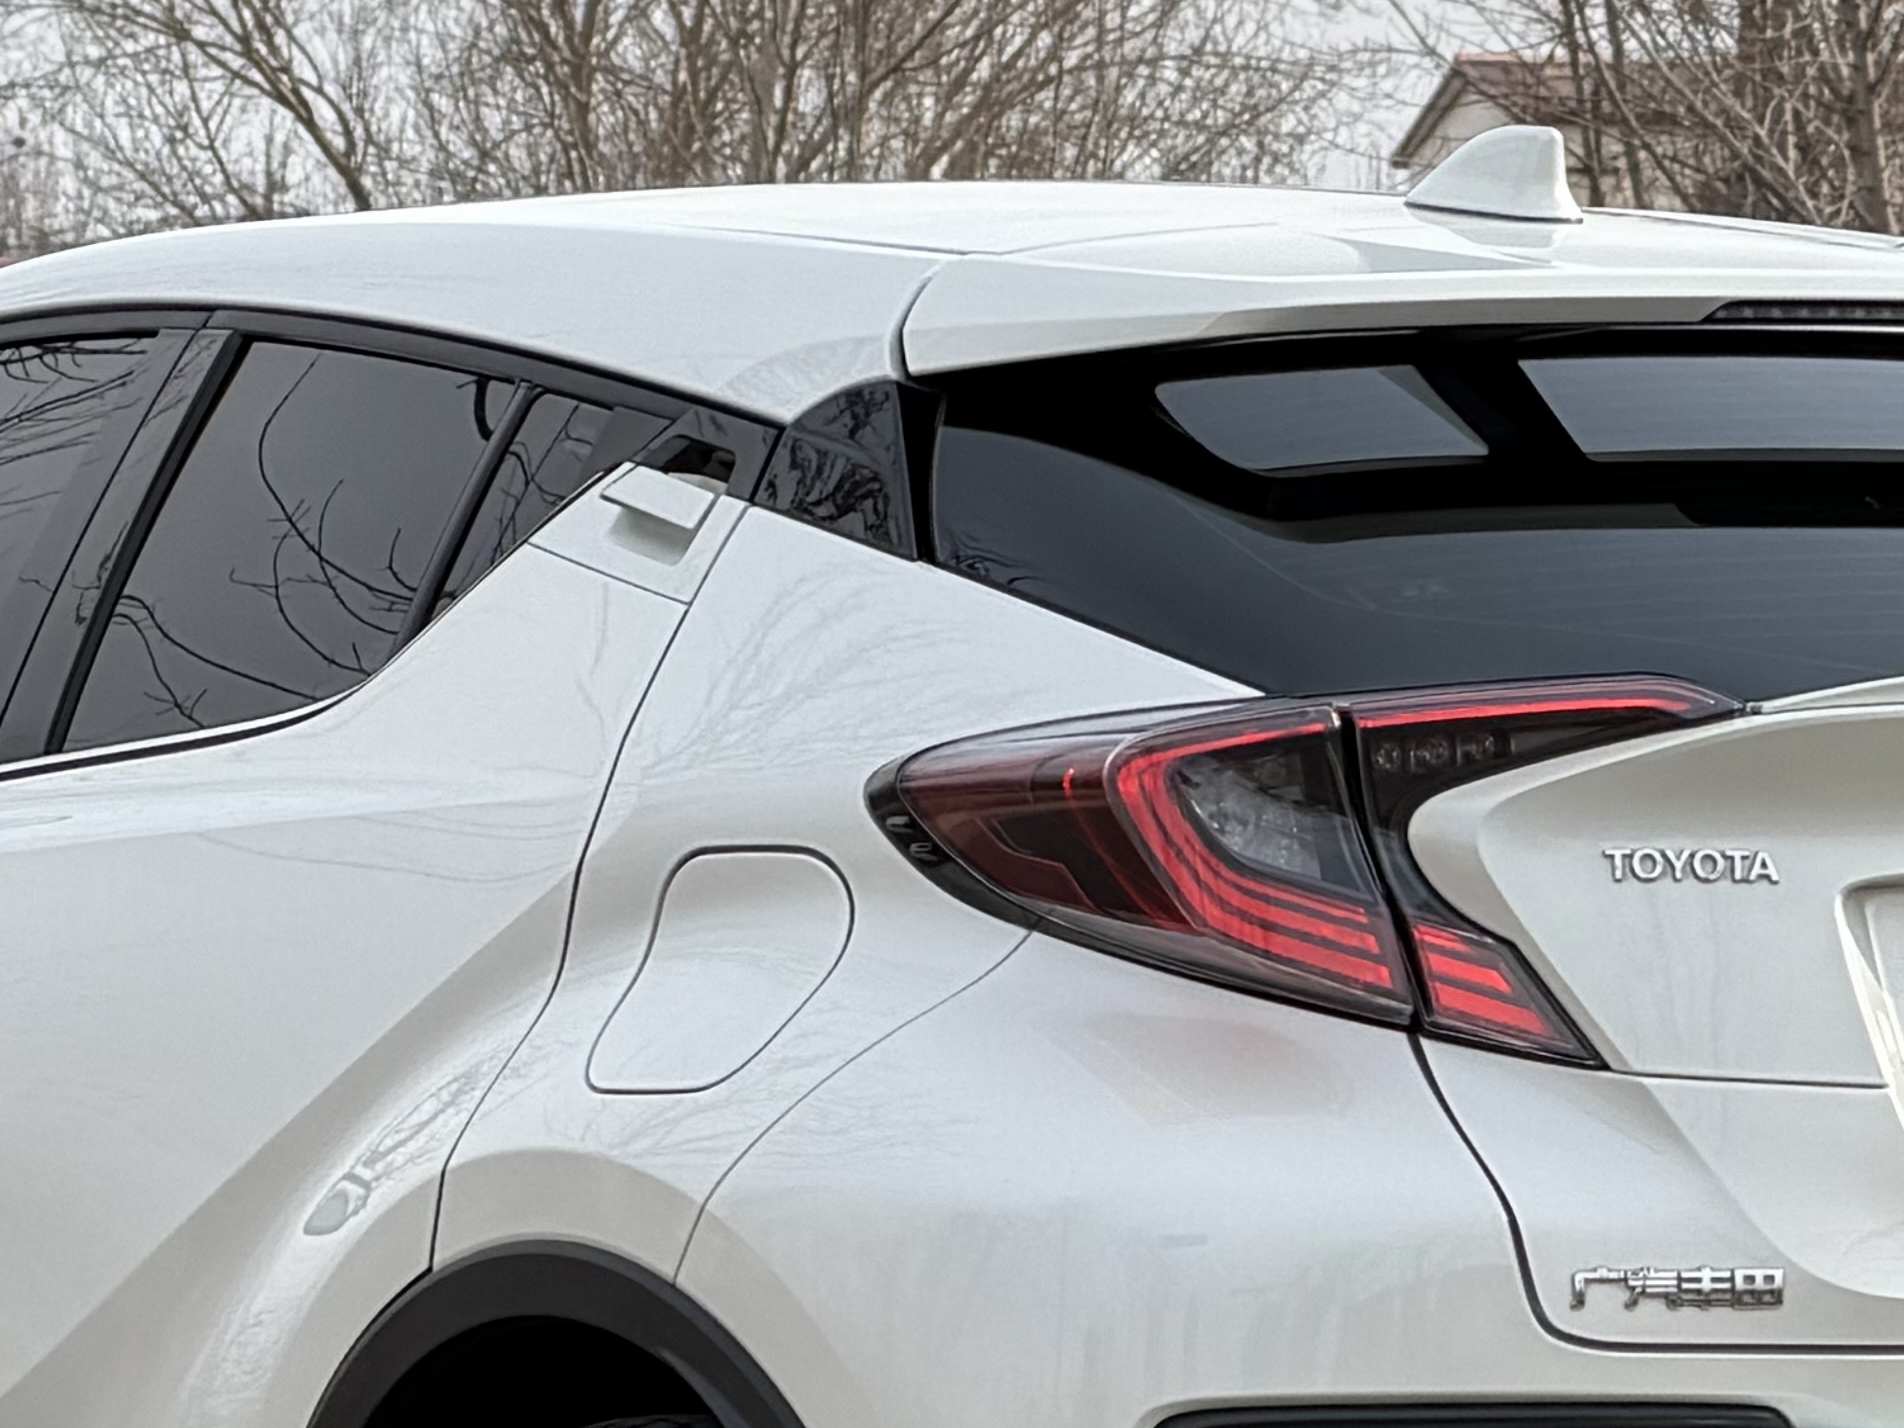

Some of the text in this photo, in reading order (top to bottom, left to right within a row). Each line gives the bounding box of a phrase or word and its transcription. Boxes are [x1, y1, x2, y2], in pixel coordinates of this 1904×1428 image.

[1602, 847, 1781, 884] TOYOTA
[1569, 1265, 1784, 1311] 广汽丰田
